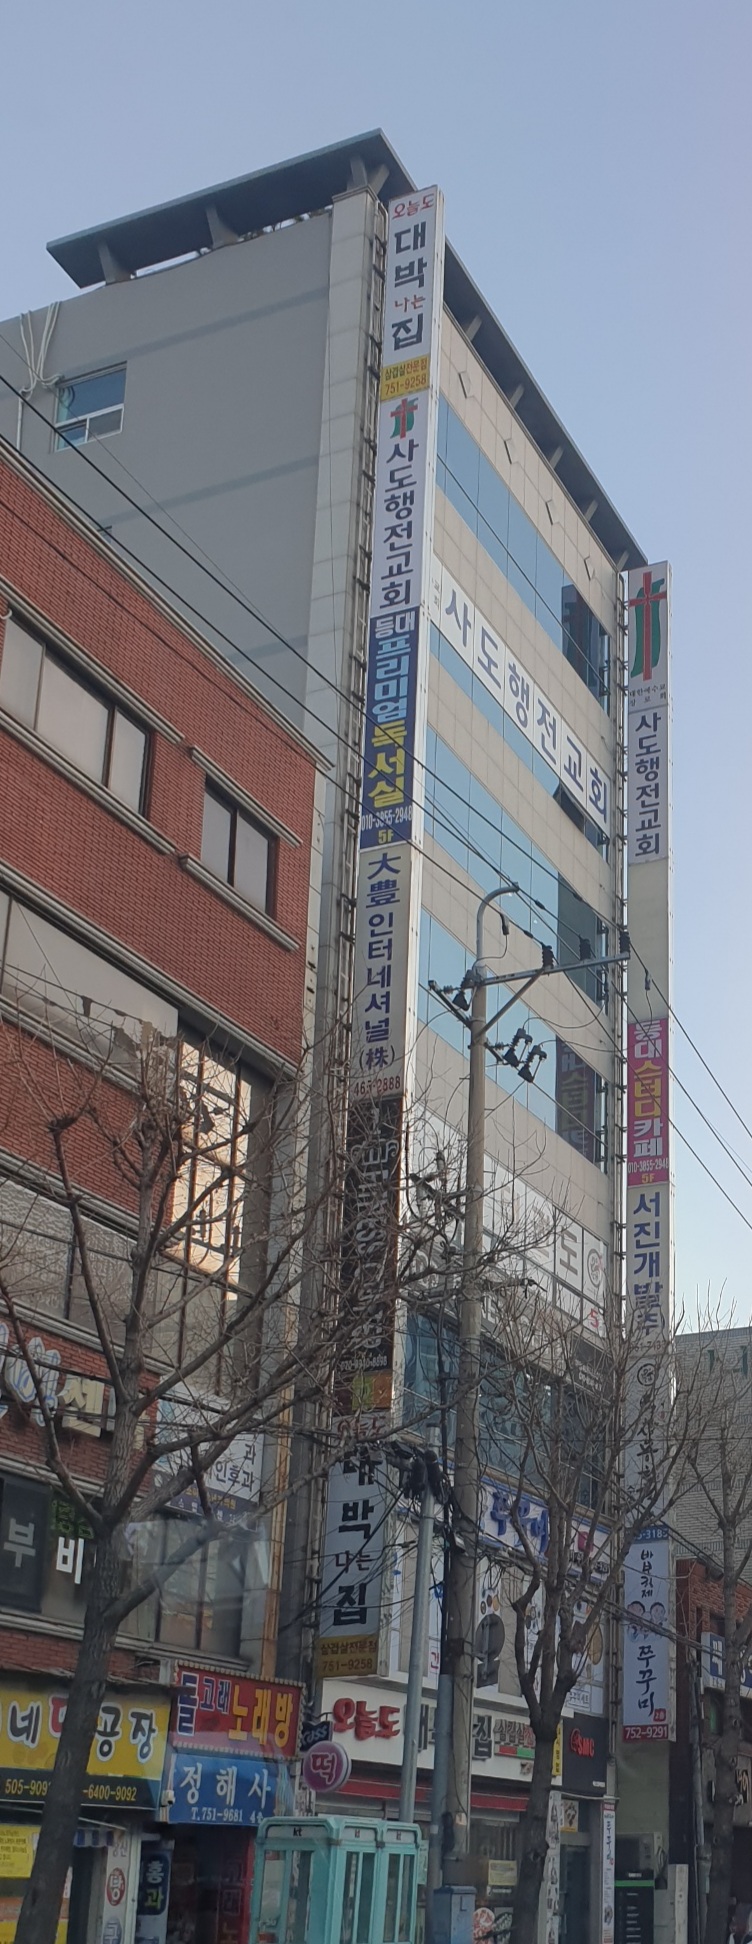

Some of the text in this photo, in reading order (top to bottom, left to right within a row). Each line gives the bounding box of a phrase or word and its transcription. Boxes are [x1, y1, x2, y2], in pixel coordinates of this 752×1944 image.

[391, 193, 435, 220] 오늘도
[394, 221, 428, 288] 대박
[394, 294, 426, 313] 나는
[391, 313, 424, 351] 집
[384, 375, 428, 396] 751-9258
[379, 438, 420, 610] 사도행전교회
[374, 611, 416, 640] 등대
[371, 635, 412, 724] 프리미엄
[446, 588, 609, 824] 사도행전교회
[367, 720, 408, 809] 독서실
[635, 712, 662, 858] 사도행전교회
[377, 829, 394, 844] 5F
[641, 1173, 655, 1184] 5F
[332, 1583, 368, 1626] 집
[322, 1657, 374, 1673] 751-9258
[178, 1673, 293, 1747] 돌고래 노래방
[333, 1697, 400, 1740] 오늘도
[624, 1727, 668, 1740] 752-9291
[191, 1806, 243, 1823] T.751-9681
